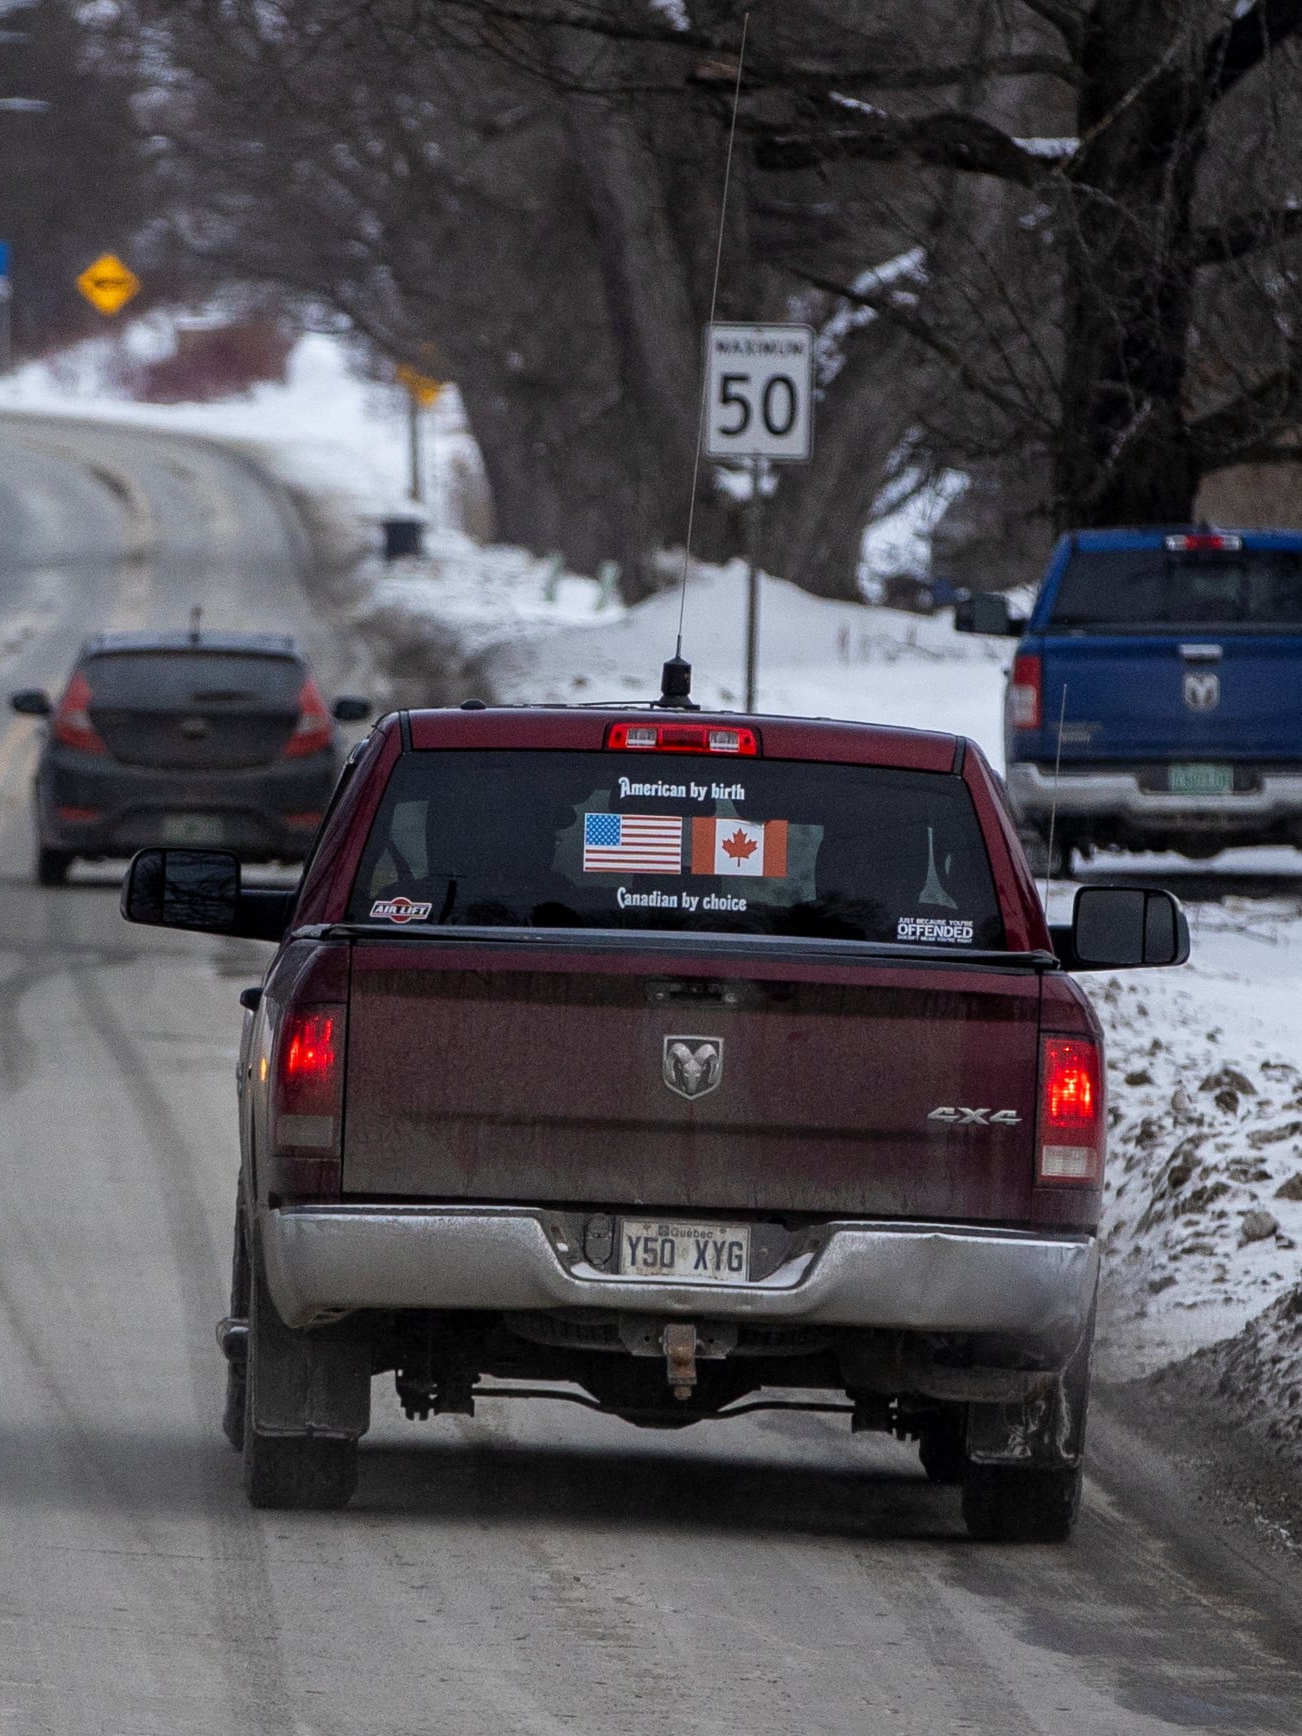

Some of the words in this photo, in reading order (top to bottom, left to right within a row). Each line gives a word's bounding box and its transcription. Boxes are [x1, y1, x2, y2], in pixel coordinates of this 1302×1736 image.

[718, 372, 797, 435] 50
[618, 776, 686, 799] American
[690, 781, 708, 801] by
[711, 782, 745, 800] birth
[374, 905, 398, 914] AIR
[399, 906, 427, 915] LIFT
[617, 886, 678, 909] Canadian
[681, 891, 699, 911] by
[702, 893, 747, 911] choice
[897, 923, 973, 938] OFFENDED
[670, 1226, 714, 1239] Québec
[627, 1235, 675, 1268] Y50
[693, 1239, 744, 1272] XYG
